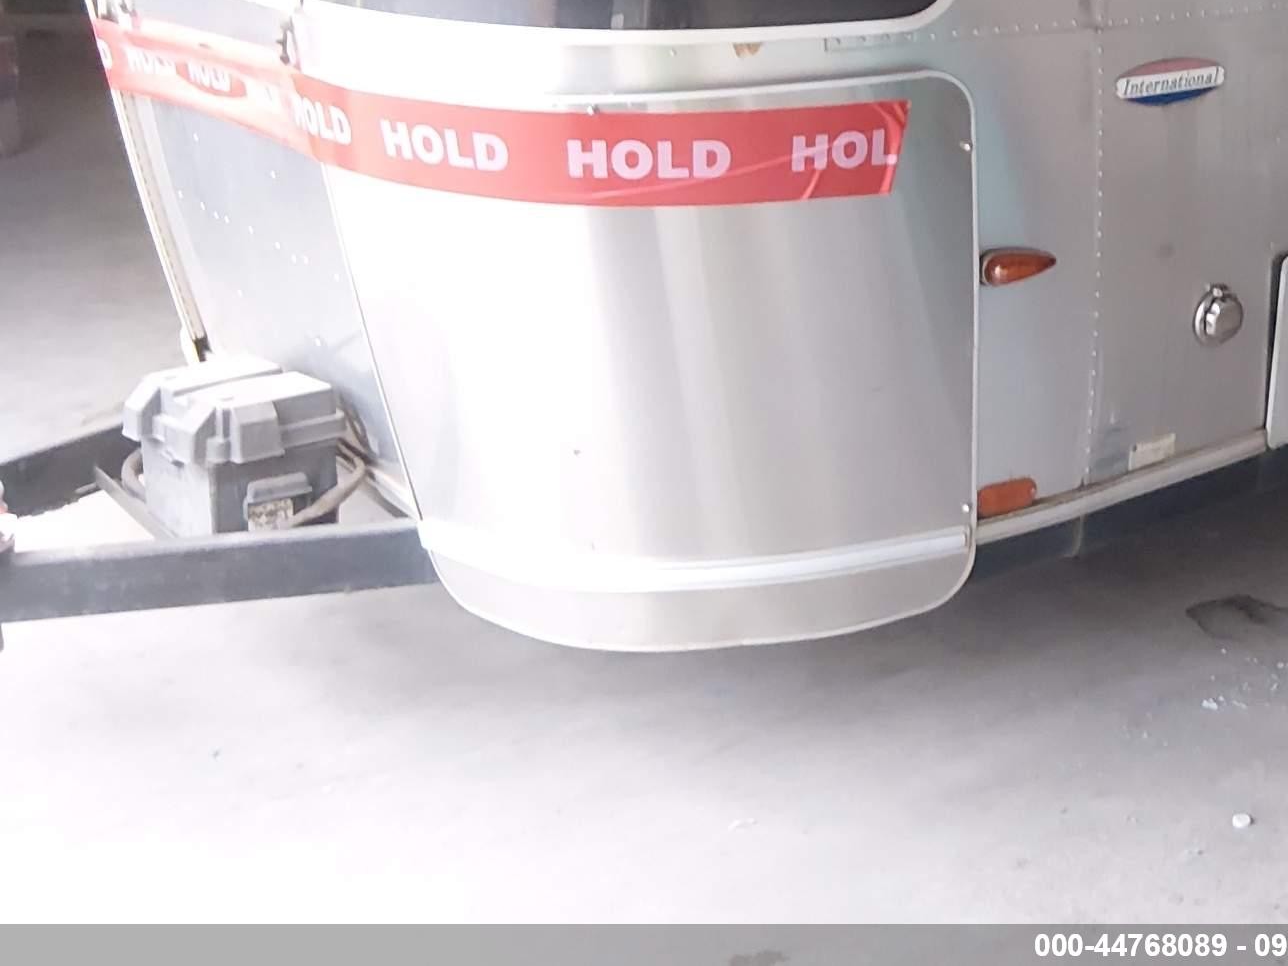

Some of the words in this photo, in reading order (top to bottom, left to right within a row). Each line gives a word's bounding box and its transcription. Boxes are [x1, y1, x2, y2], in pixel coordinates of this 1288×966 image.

[1123, 67, 1219, 96] International
[290, 92, 352, 146] HOLD
[379, 118, 509, 172] HOLD
[566, 139, 731, 180] HOLD
